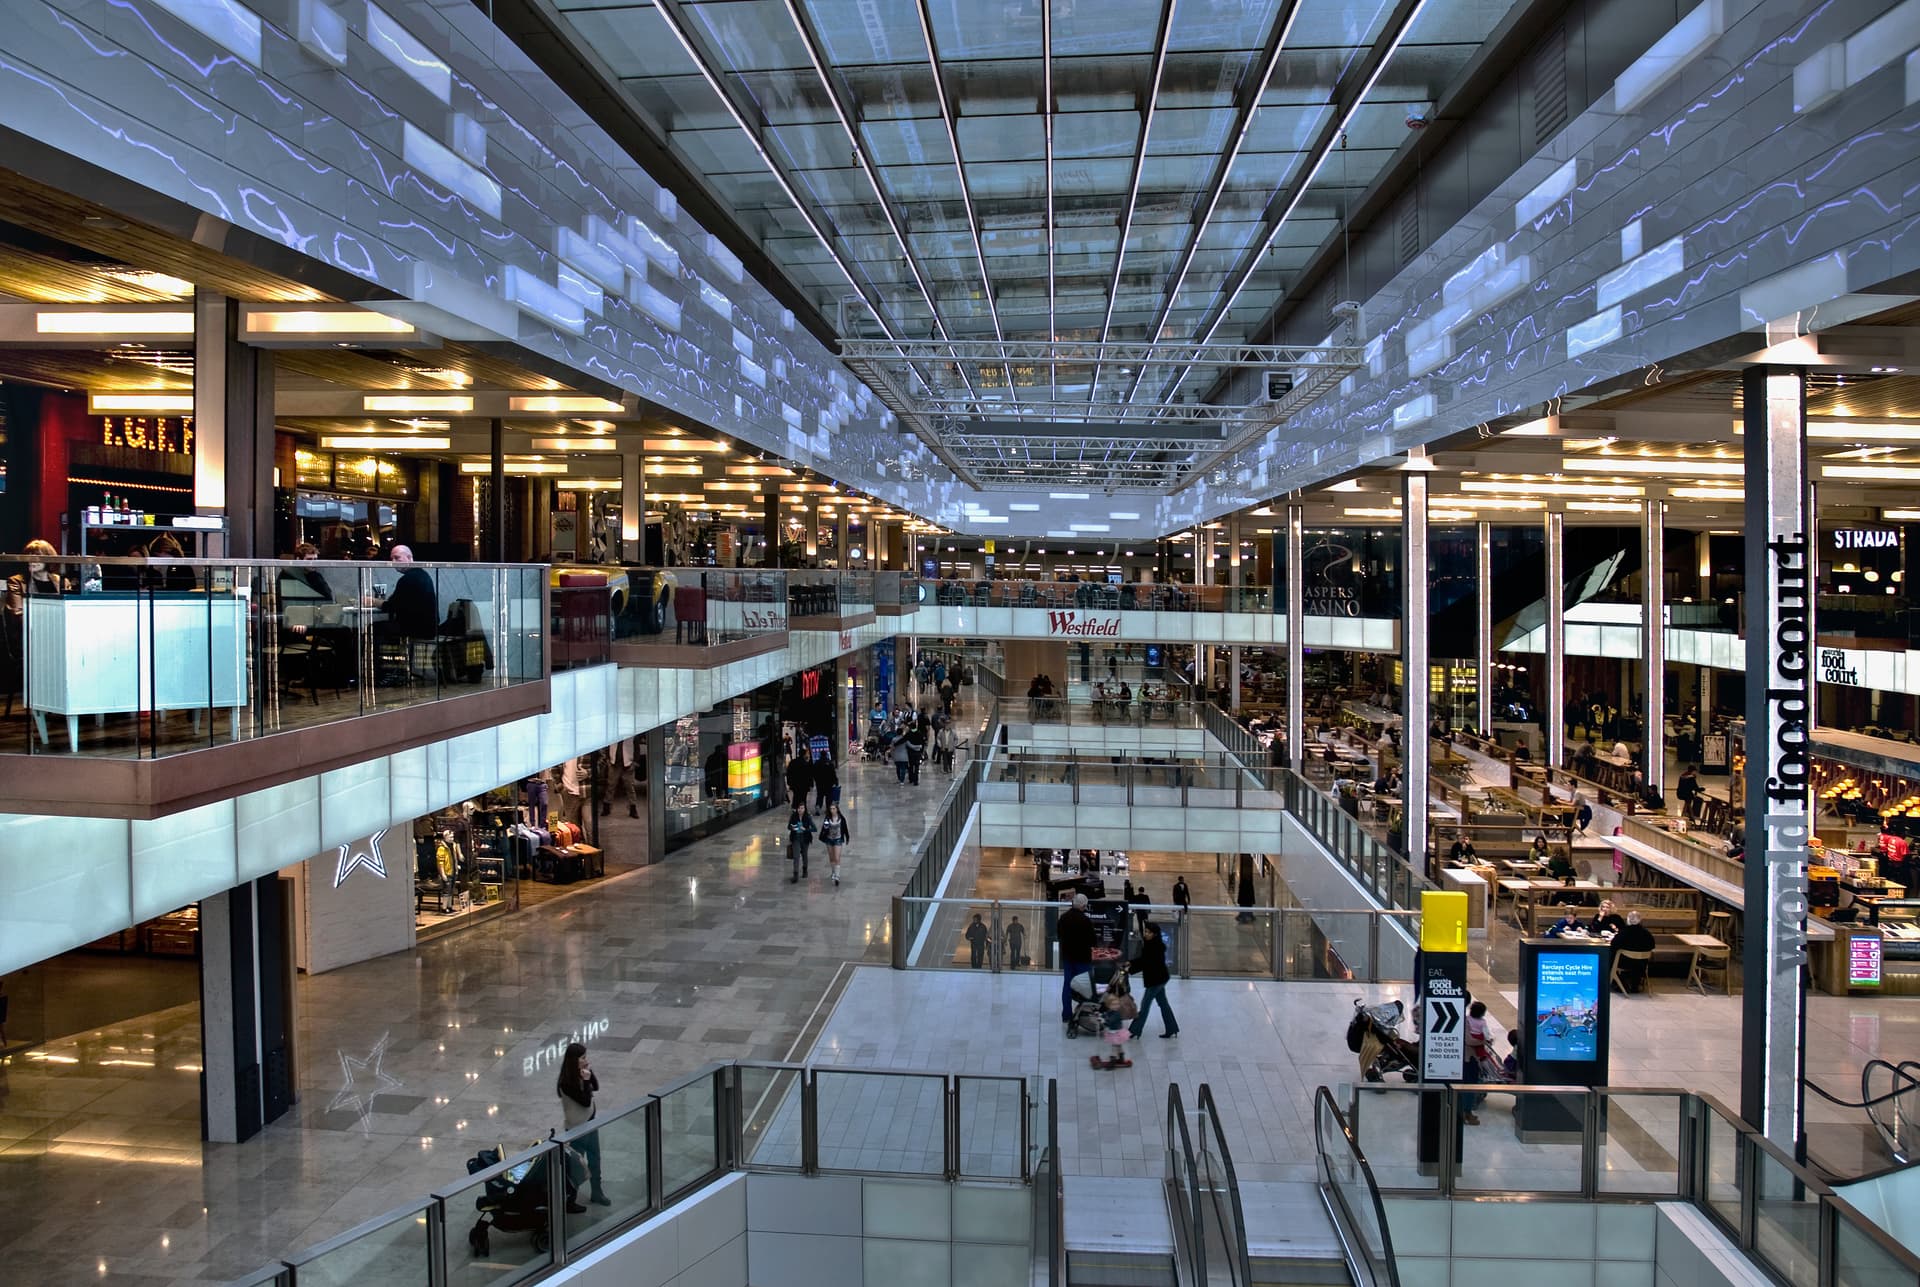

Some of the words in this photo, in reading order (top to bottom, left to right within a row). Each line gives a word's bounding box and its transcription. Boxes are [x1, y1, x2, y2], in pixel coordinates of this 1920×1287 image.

[1834, 531, 1898, 549] STRADA
[1304, 587, 1354, 599] ASPERS
[1765, 531, 1810, 684] court
[1047, 611, 1121, 636] Westfield
[1821, 650, 1846, 670] food
[802, 670, 820, 700] hmv
[1825, 666, 1858, 685] court
[1764, 688, 1810, 809] food
[1764, 811, 1809, 976] world
[1429, 979, 1452, 989] food
[1432, 986, 1463, 996] court
